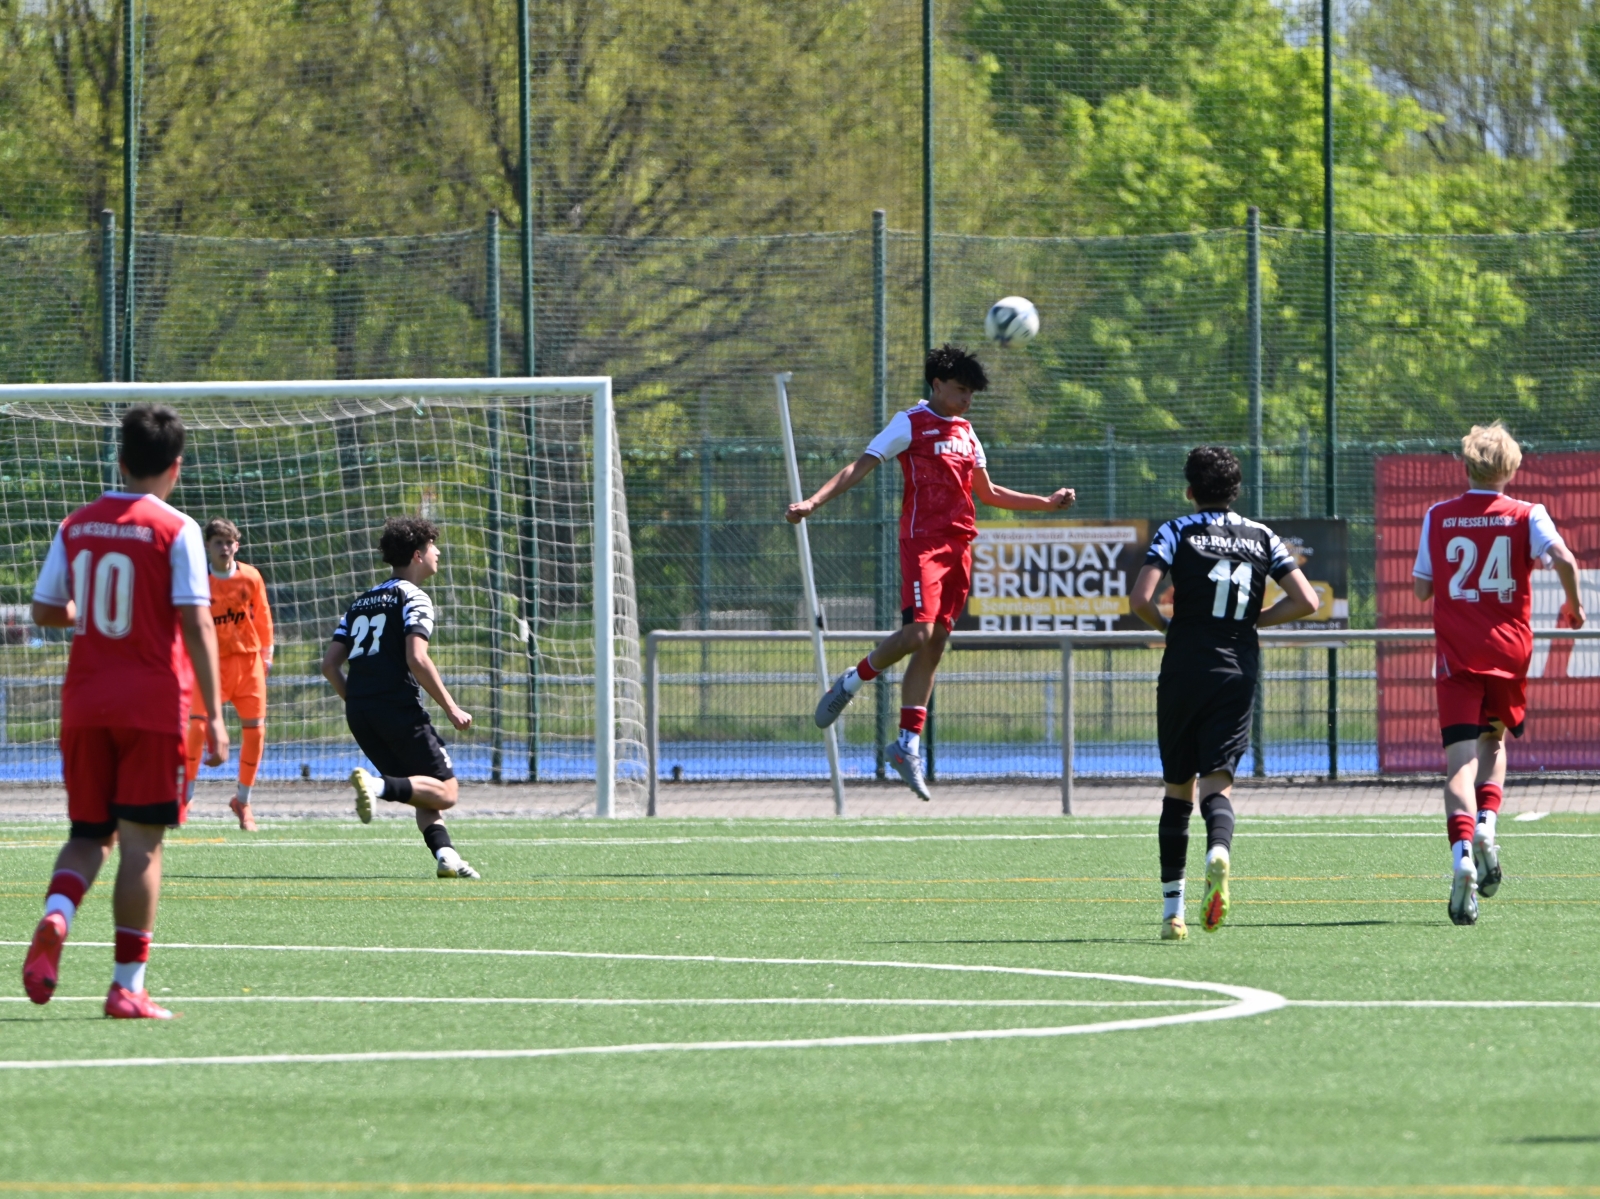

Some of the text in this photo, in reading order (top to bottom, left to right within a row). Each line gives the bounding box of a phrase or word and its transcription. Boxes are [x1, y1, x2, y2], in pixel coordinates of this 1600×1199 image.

[1443, 517, 1457, 528] KSV
[1458, 516, 1488, 528] HESSEN
[974, 543, 1124, 571] SUNDAY
[1190, 535, 1264, 553] GERMANIA
[1446, 535, 1516, 603] 24
[72, 549, 135, 640] 10
[973, 571, 1126, 598] BRUNCH
[1208, 558, 1252, 620] 11
[351, 594, 398, 608] GERMANIA
[981, 600, 1050, 615] Sonntags
[1093, 600, 1120, 611] Uhr
[213, 608, 246, 625] mhp
[348, 613, 386, 660] 27
